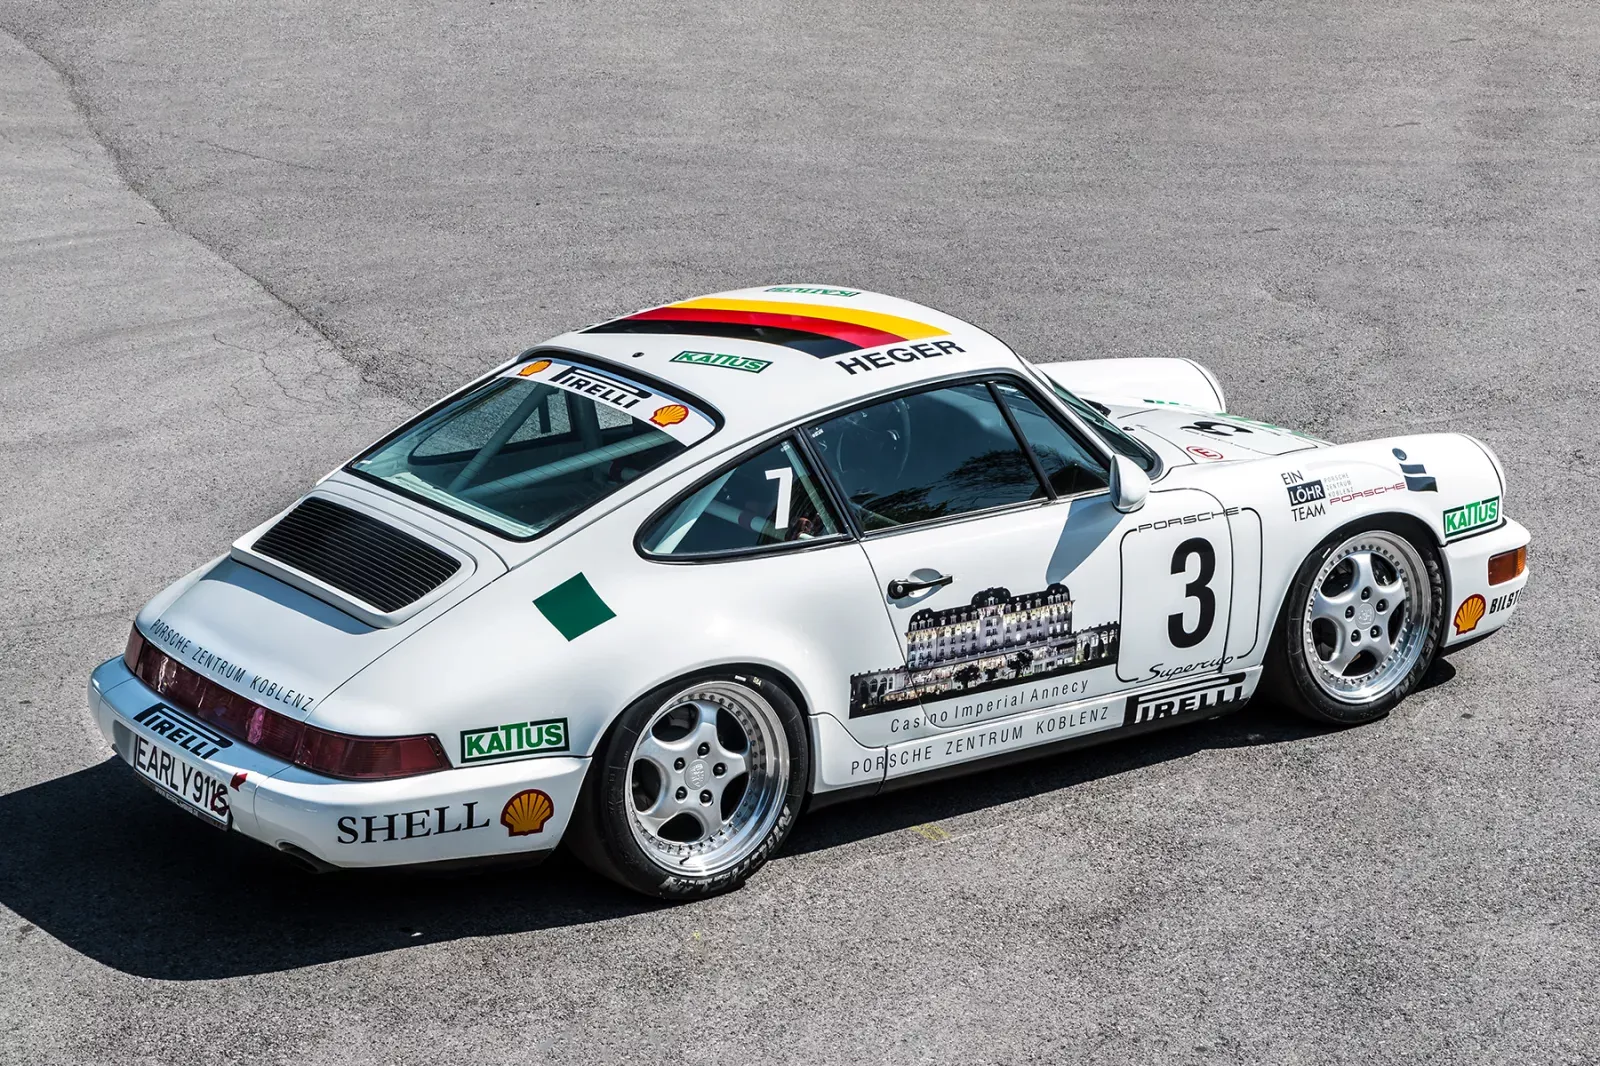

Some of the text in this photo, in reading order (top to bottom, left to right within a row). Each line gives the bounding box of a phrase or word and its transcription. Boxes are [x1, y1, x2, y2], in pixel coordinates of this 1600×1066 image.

[678, 353, 765, 372] KATTUS
[835, 340, 966, 375] HEGER
[548, 365, 653, 409] PIRELLI
[1281, 470, 1304, 485] EIN
[1324, 472, 1350, 483] PORSCHE
[1326, 480, 1352, 491] ZENTRUM
[1328, 487, 1354, 498] KOBLENZ
[1329, 482, 1406, 505] PORSCHE
[1290, 485, 1324, 505] LÖHR
[1138, 507, 1239, 533] PORSCHE
[1291, 503, 1326, 522] TEAM
[1446, 500, 1497, 533] KATTUS
[1167, 537, 1216, 649] 3
[150, 618, 314, 722] PORSCHE ZENTRUM KOBLENZ
[890, 679, 1089, 733] Casino Imperial Annecy
[1124, 672, 1247, 729] PIRELLI
[133, 702, 233, 760] PIRELLI
[466, 722, 563, 757] KATTUS
[851, 706, 1109, 775] PORSCHE ZENTRUM KOBLENZ
[337, 801, 490, 845] SHELL
